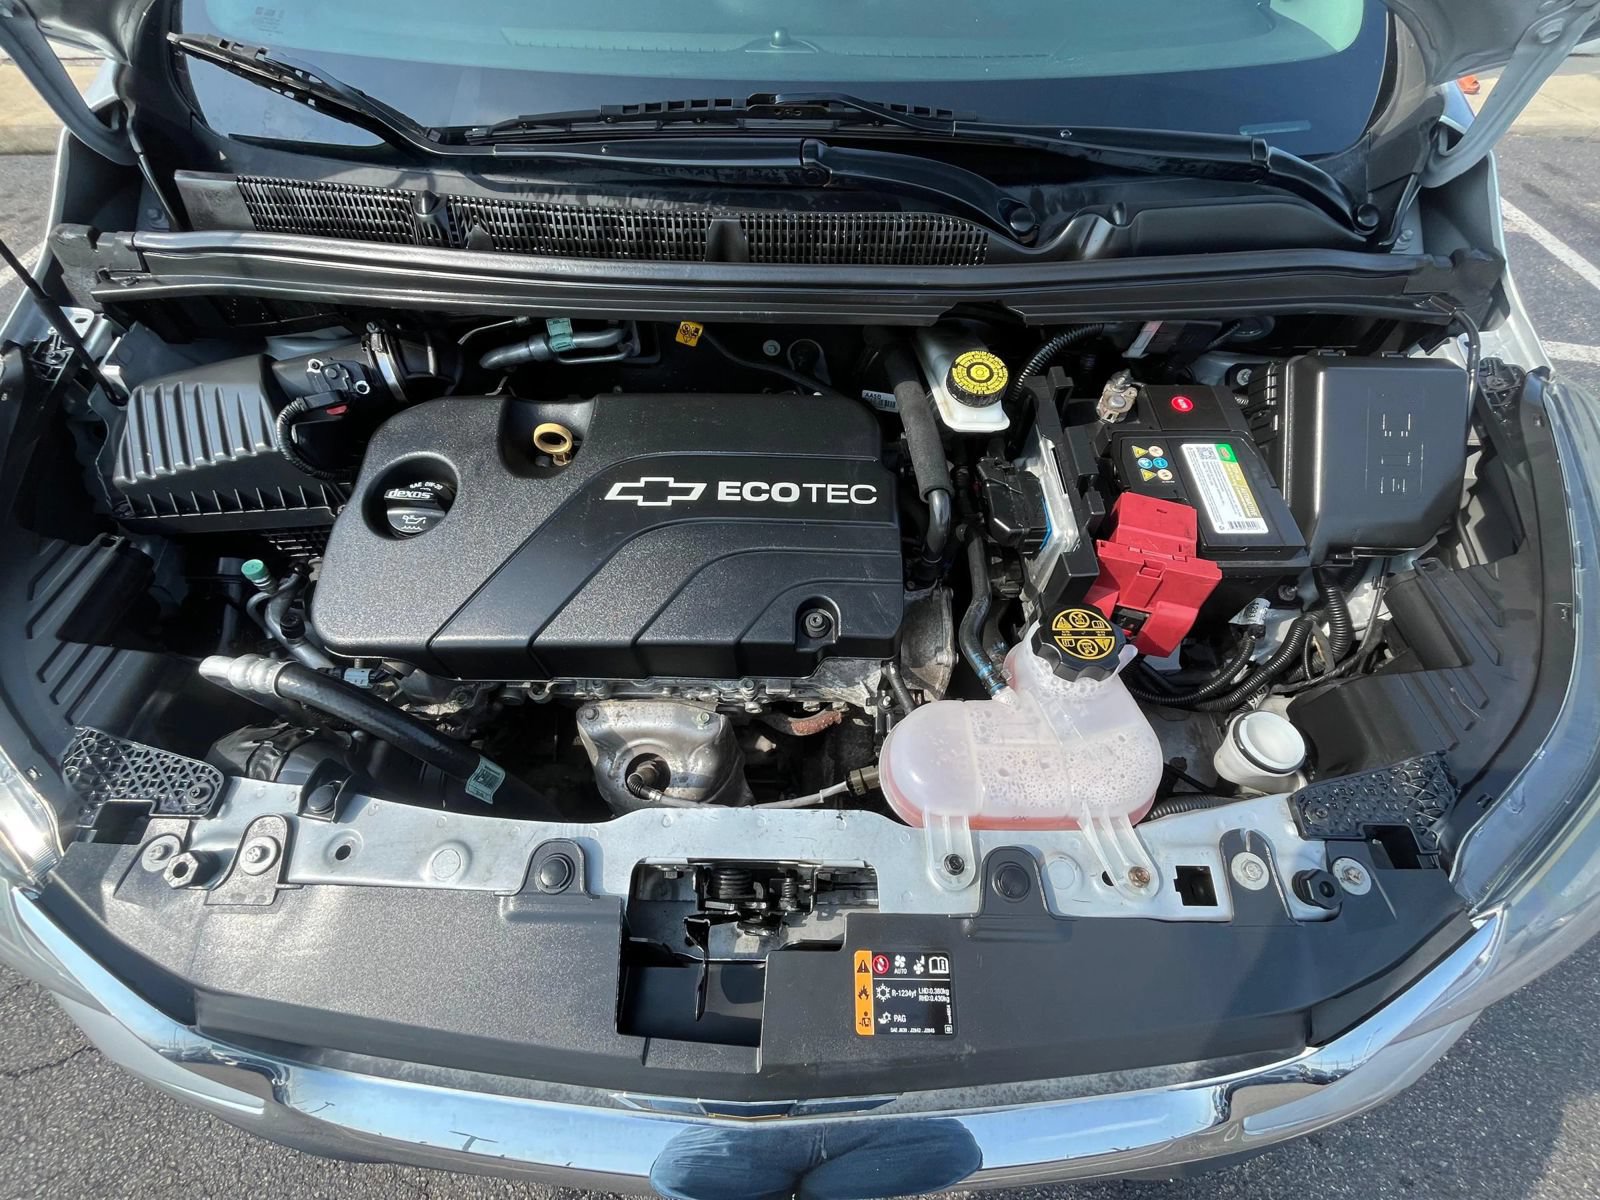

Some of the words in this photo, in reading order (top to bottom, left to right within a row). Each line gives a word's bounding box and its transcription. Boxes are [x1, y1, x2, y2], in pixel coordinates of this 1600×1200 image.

[388, 488, 434, 499] dexos
[717, 481, 878, 505] ECOTEC
[893, 1014, 907, 1023] PAG
